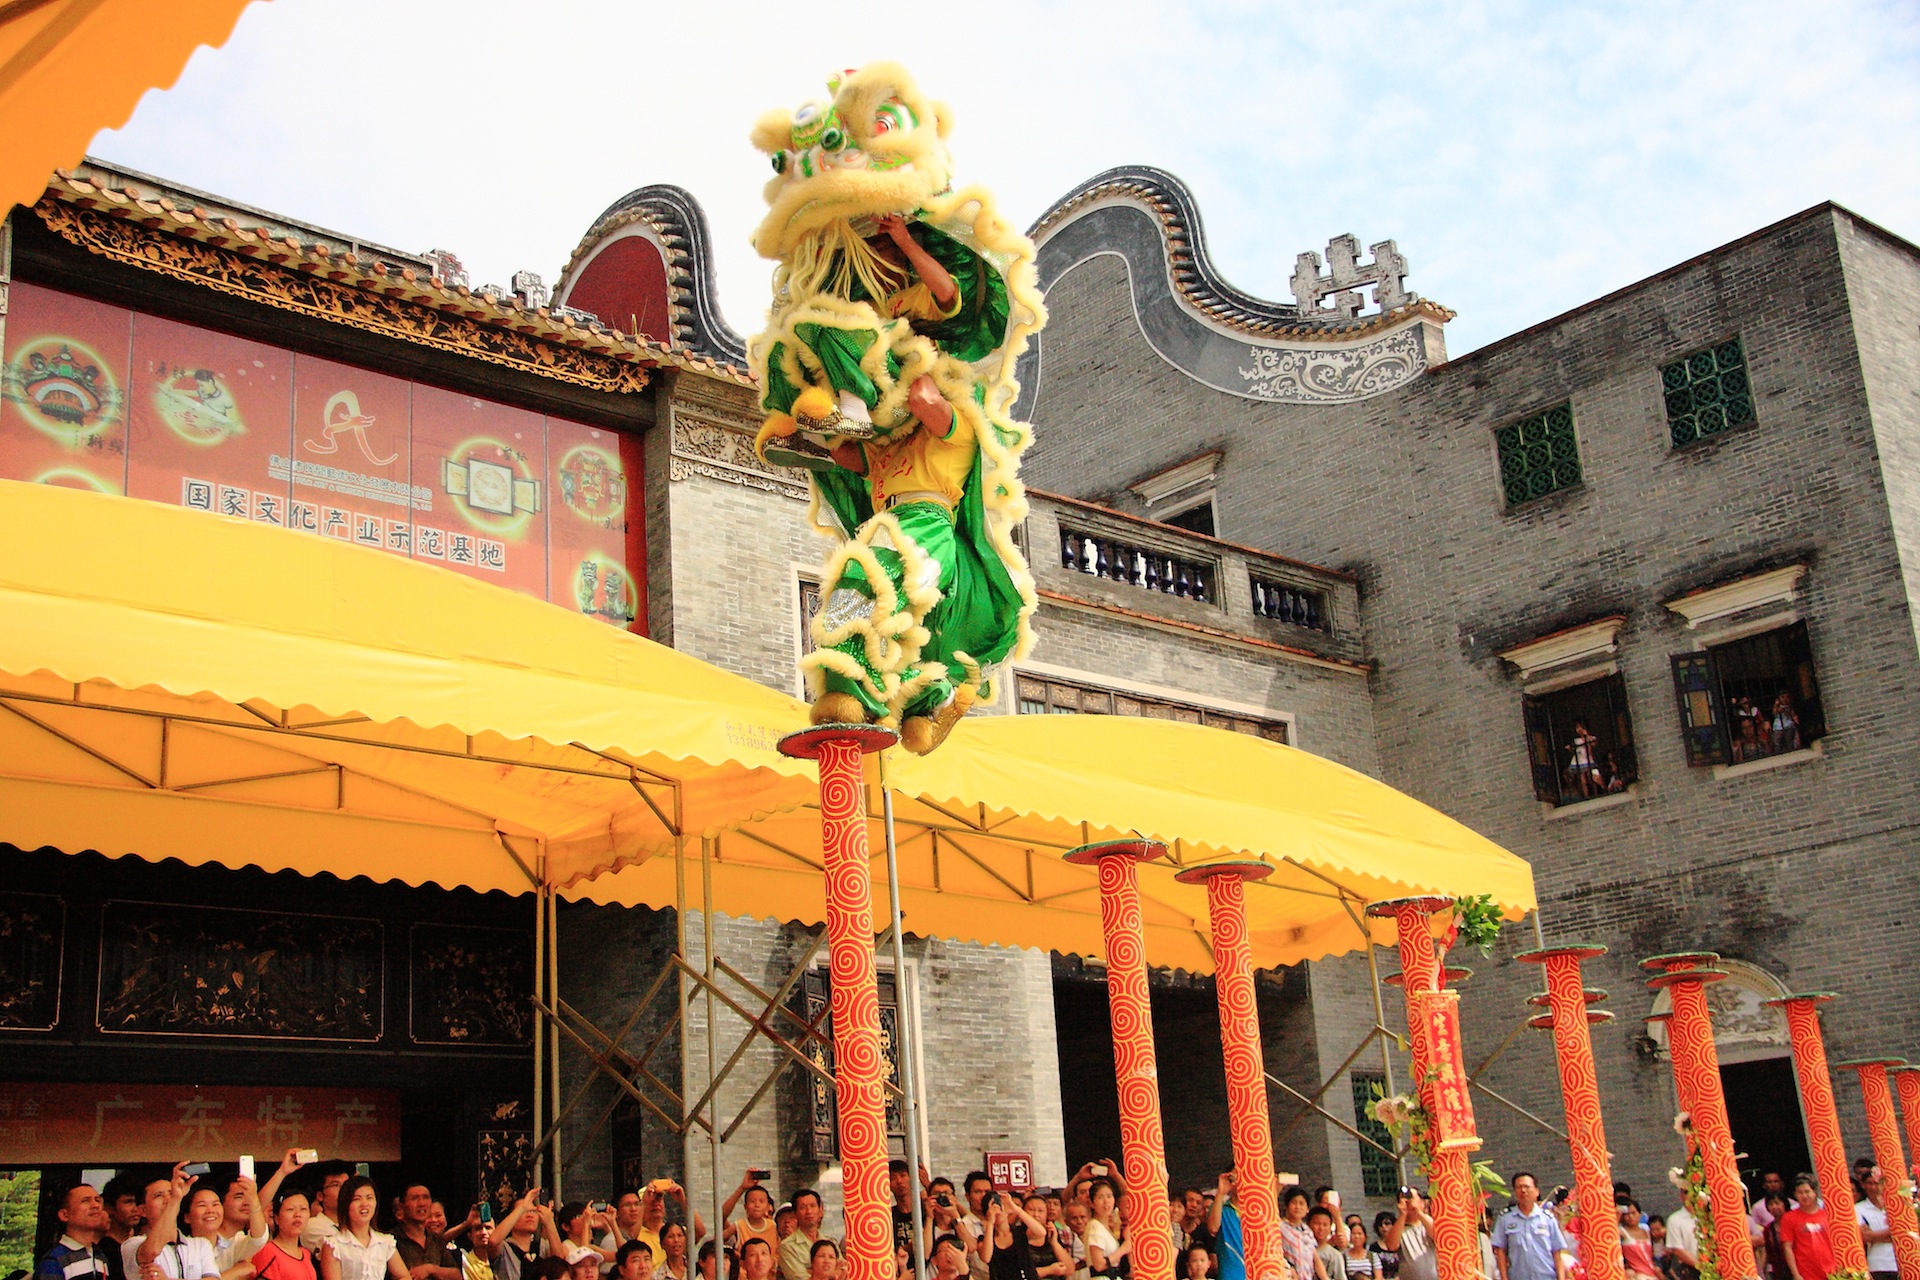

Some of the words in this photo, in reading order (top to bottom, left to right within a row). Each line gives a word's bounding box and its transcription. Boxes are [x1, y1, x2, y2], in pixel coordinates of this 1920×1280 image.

[186, 481, 505, 568] 国家文化产业示范基地
[88, 1093, 379, 1148] 广东特产
[992, 1161, 1009, 1176] 出口
[994, 1176, 1008, 1185] Exit
